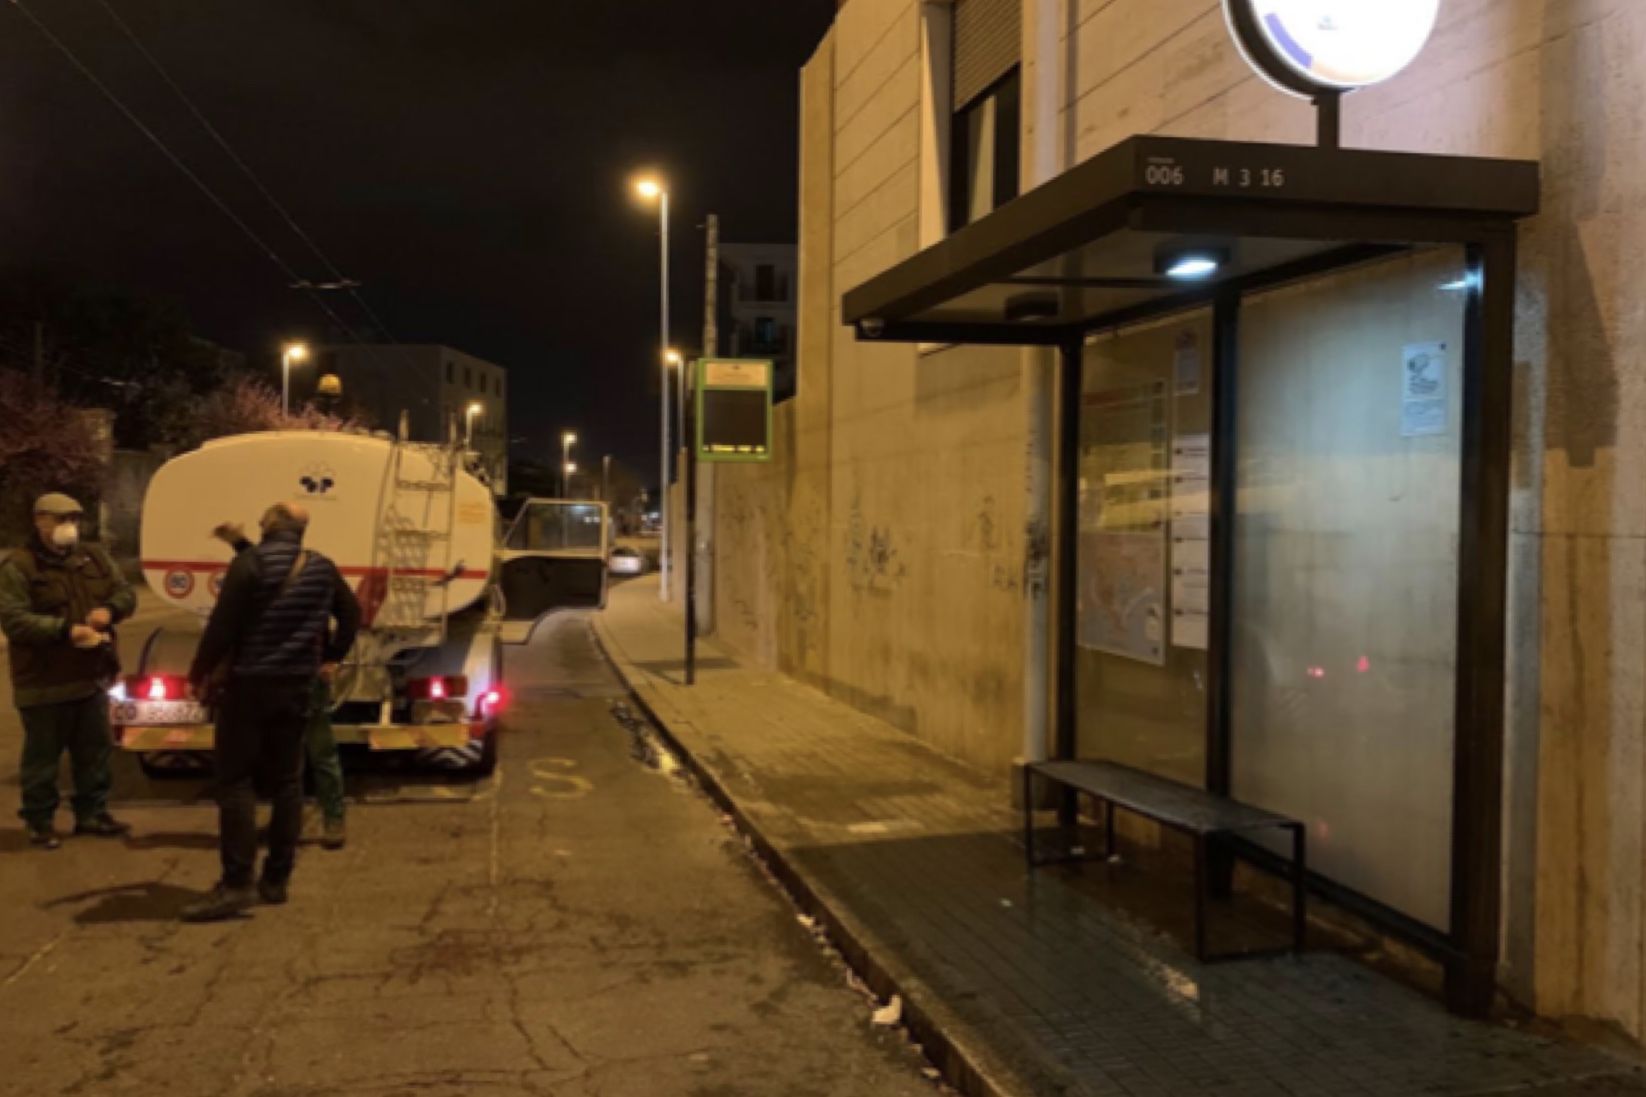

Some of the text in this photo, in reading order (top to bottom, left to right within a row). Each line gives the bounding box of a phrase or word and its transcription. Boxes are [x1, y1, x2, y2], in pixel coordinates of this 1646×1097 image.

[1145, 165, 1285, 187] 006 M 3 16
[527, 756, 594, 800] S
